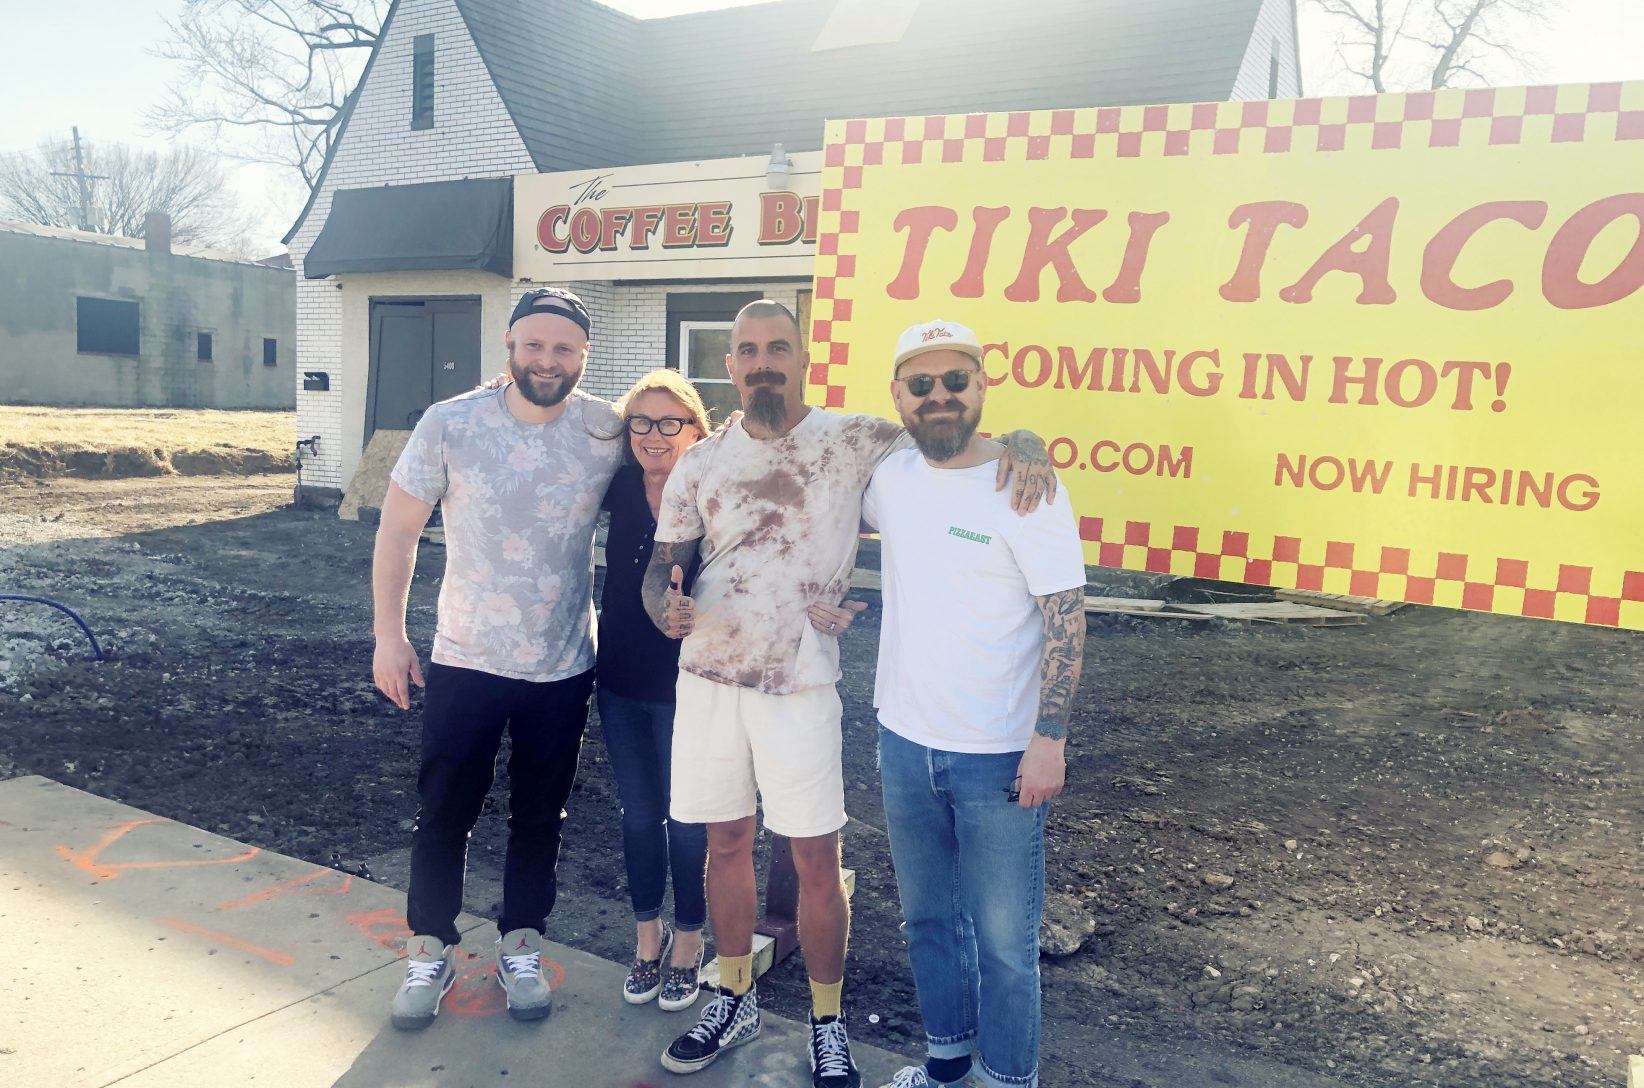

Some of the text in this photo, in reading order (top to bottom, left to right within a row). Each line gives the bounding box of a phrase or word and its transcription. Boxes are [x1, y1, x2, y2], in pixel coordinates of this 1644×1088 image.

[569, 173, 614, 206] The
[537, 201, 733, 254] COFFEE
[886, 192, 1644, 311] TIKI TACO
[981, 341, 1512, 413] COMING IN HOT!
[1040, 435, 1601, 512] O.COM NOW HIRING
